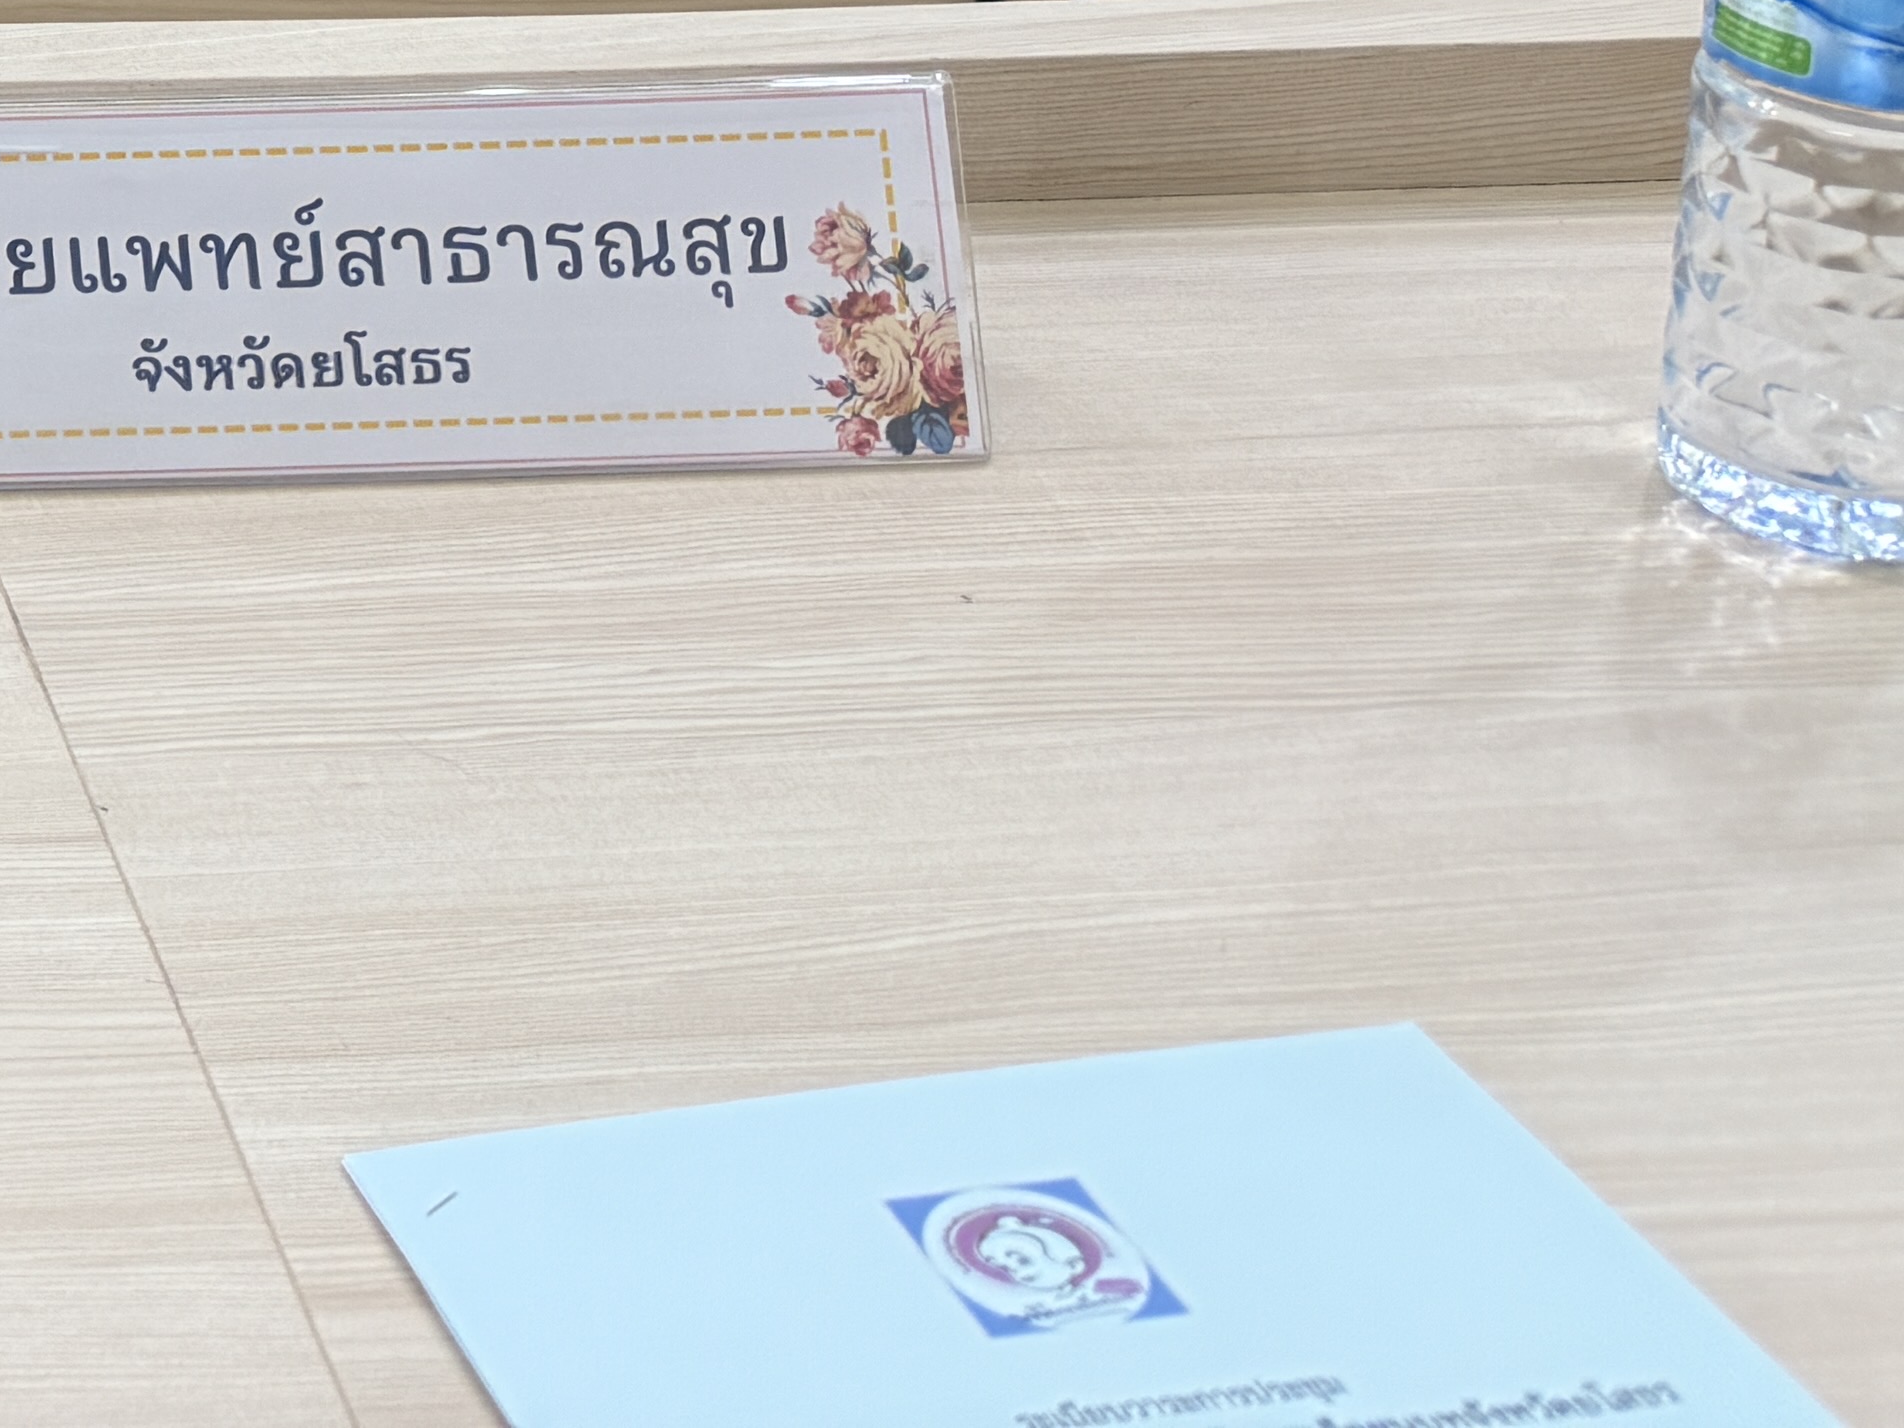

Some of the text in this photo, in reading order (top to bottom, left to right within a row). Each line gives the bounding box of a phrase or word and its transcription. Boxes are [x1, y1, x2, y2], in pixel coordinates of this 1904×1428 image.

[132, 333, 475, 394] จังหวัดยโสธร
